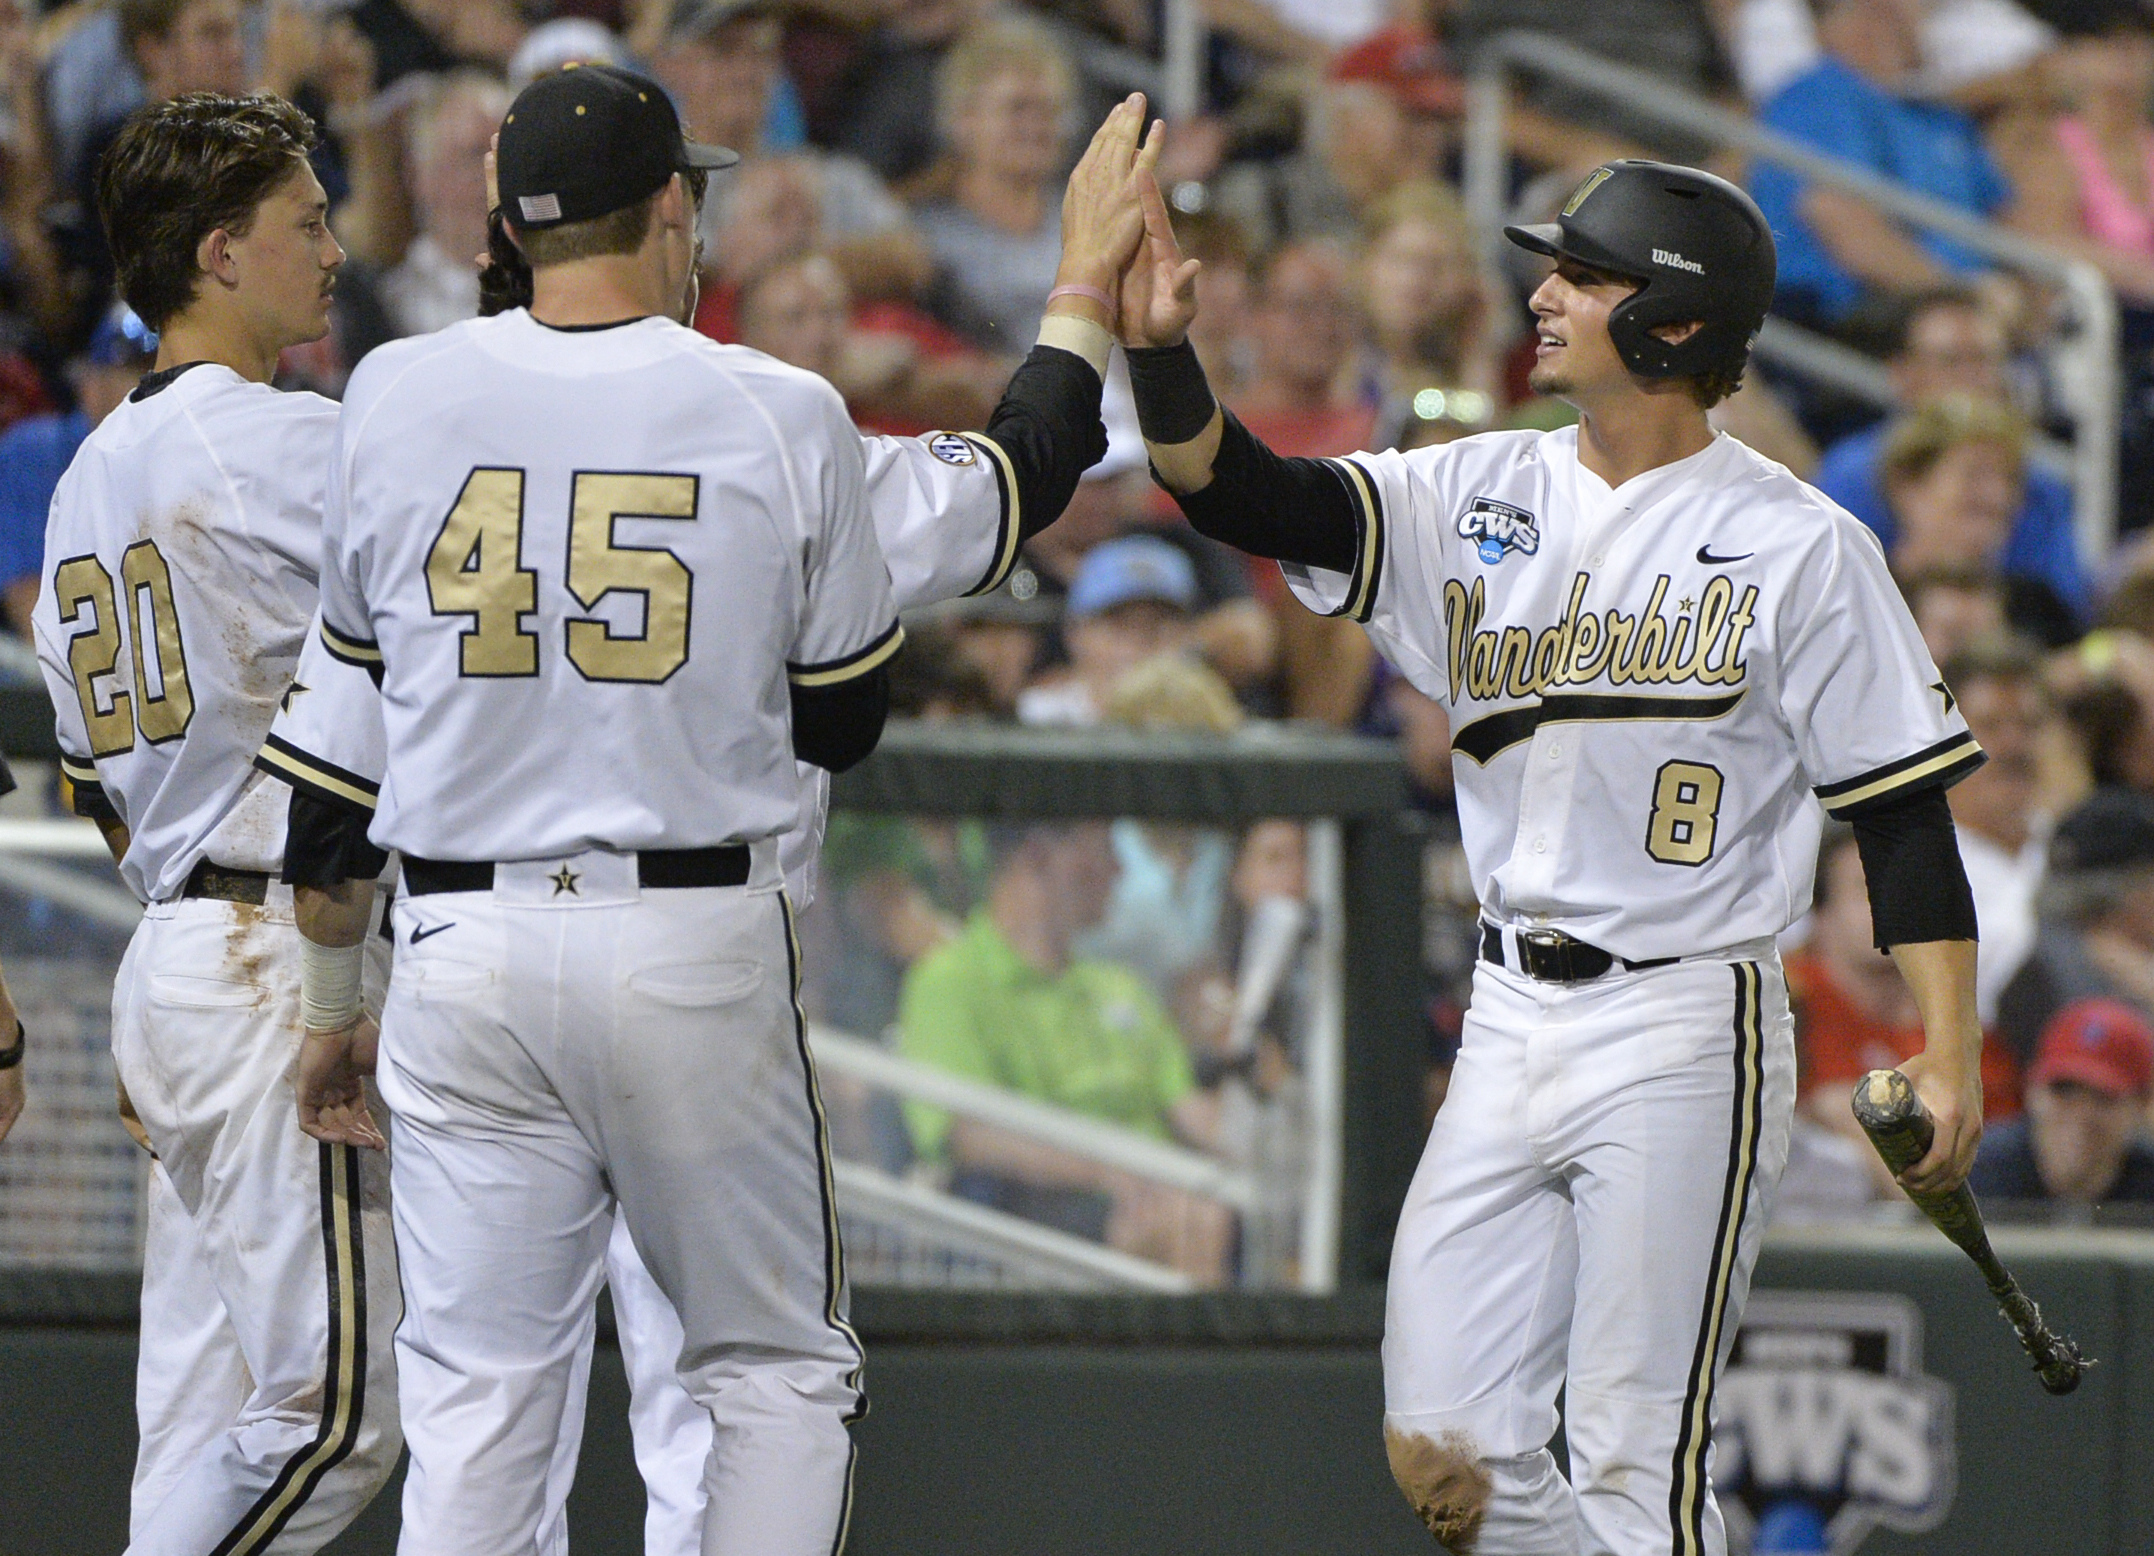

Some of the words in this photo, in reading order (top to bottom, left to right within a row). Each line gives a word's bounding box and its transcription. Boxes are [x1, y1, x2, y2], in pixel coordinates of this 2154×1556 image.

[423, 466, 700, 685] 45
[1457, 510, 1539, 554] CWS
[53, 537, 197, 760] 20
[1443, 571, 1760, 708] Vanderbilt
[1644, 758, 1725, 868] 8
